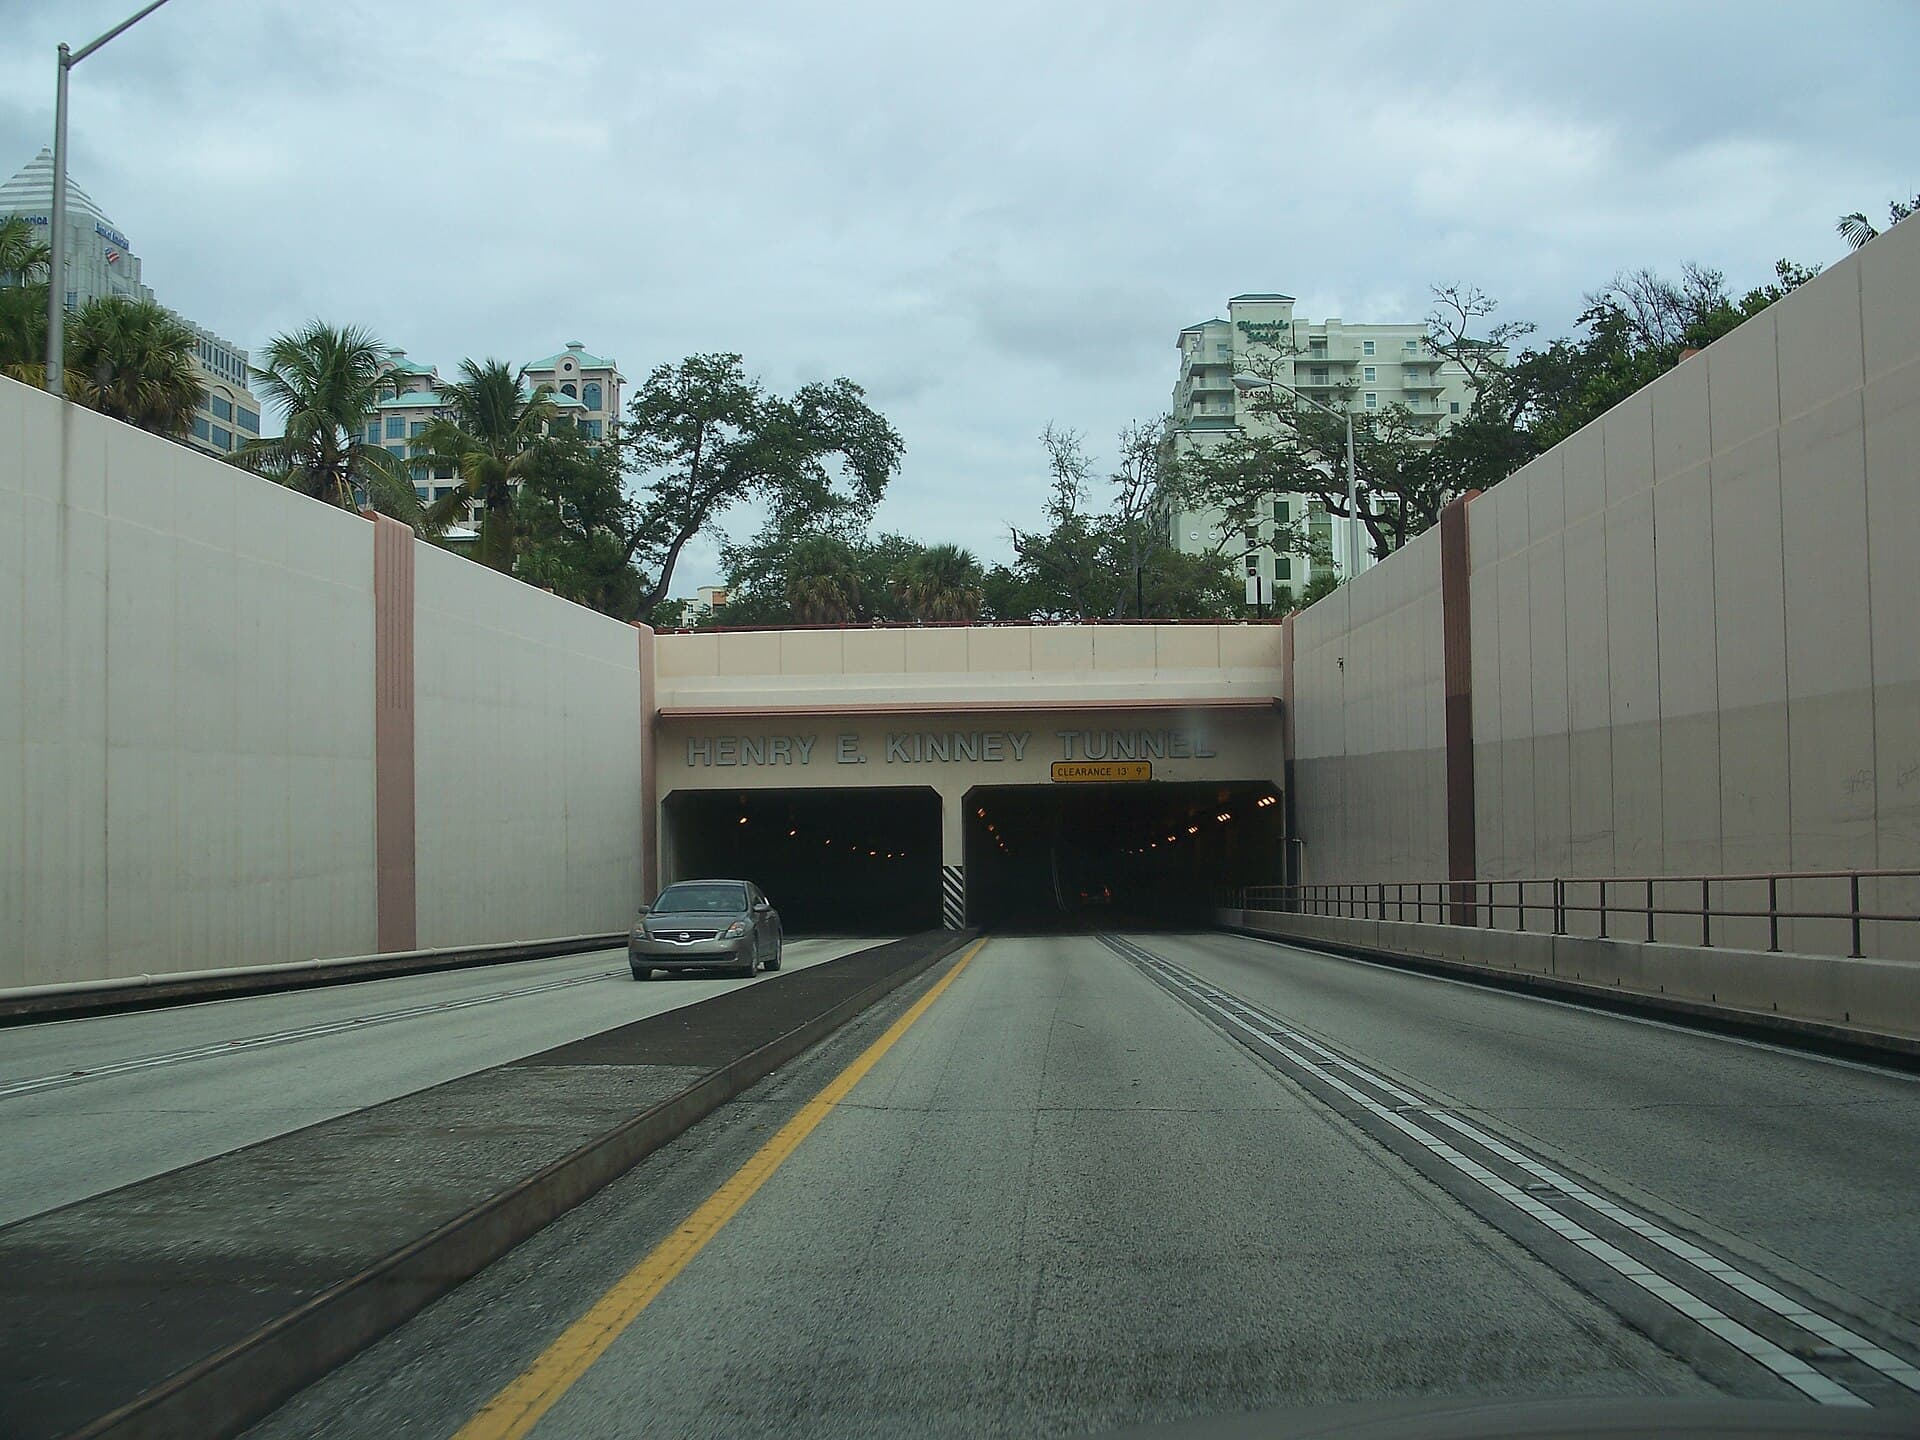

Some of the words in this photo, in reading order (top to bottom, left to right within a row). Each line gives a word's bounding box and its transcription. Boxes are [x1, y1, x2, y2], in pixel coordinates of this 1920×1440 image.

[687, 734, 816, 766] HENRY
[837, 735, 867, 764] E.
[886, 731, 1032, 763] KINNEY
[1056, 728, 1216, 760] TUNNEL
[1057, 767, 1112, 776] CLEARANCE
